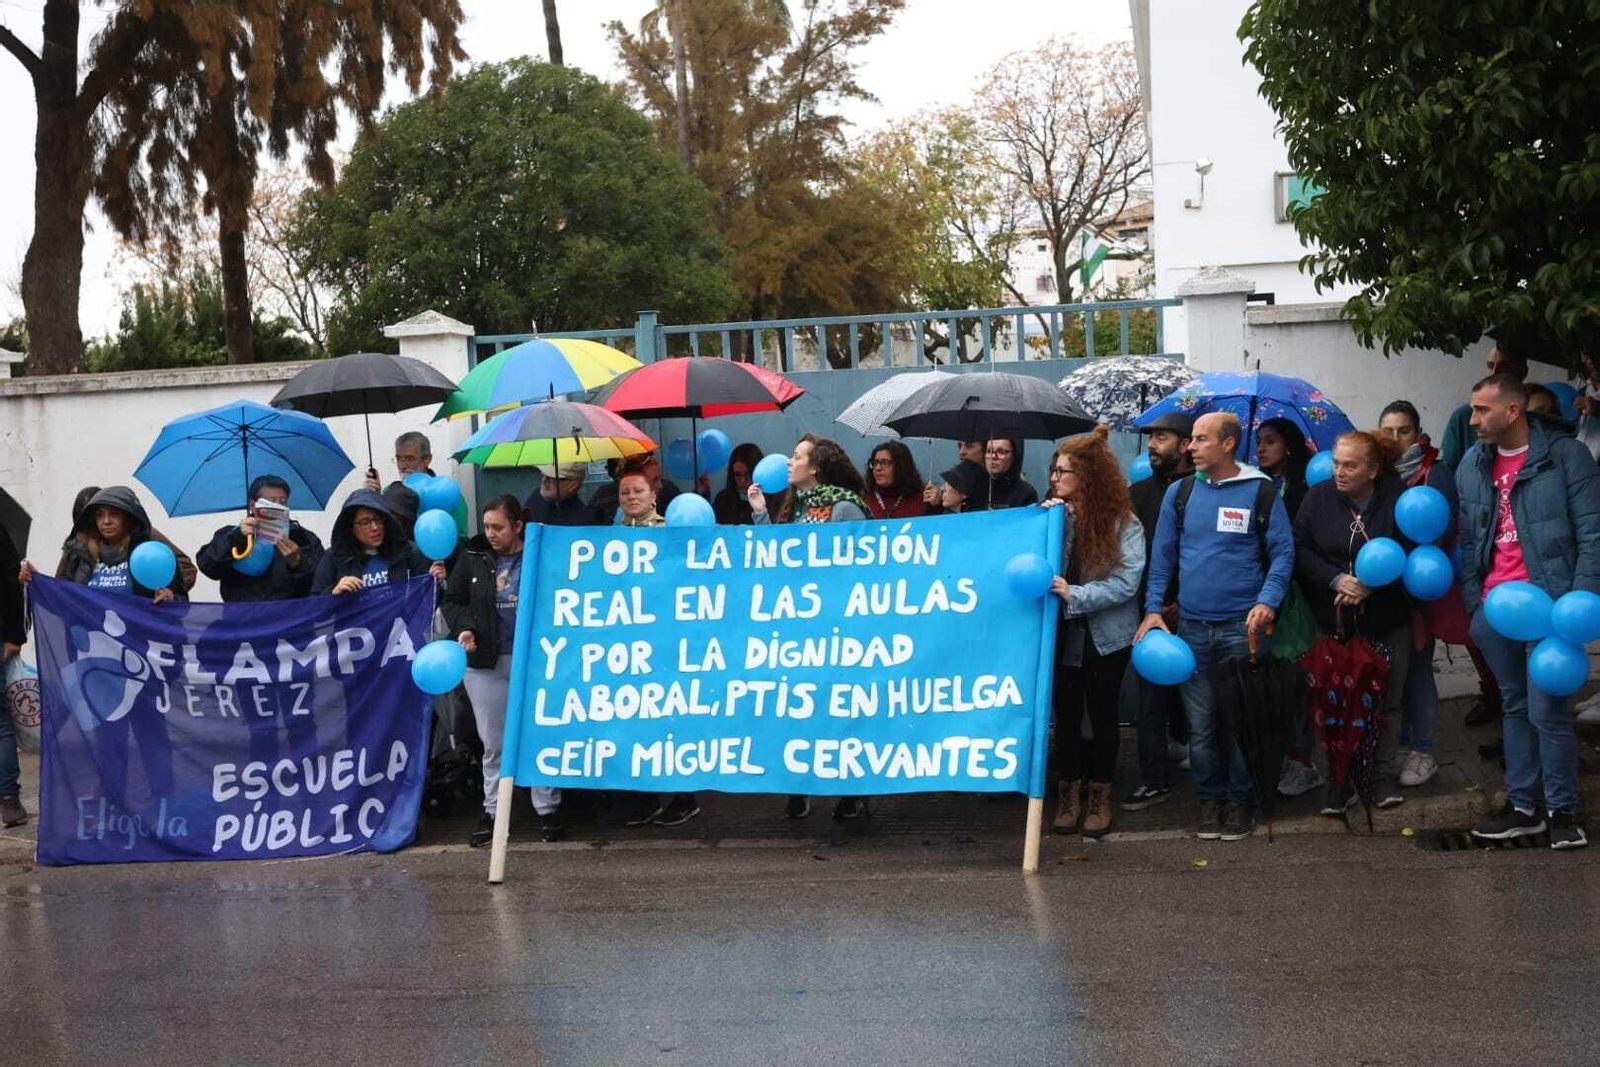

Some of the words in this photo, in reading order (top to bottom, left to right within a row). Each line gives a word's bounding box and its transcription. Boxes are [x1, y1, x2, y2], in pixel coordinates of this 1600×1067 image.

[569, 540, 657, 580] POR
[687, 538, 731, 570] LA
[554, 587, 656, 627] REAL
[675, 585, 725, 621] EN
[751, 583, 822, 621] LAS
[845, 578, 978, 617] AULAS
[147, 617, 416, 684] FLAMPA
[540, 637, 567, 680] Y
[582, 641, 653, 682] POR
[679, 638, 727, 672] LA
[155, 682, 311, 718] JEREZ
[829, 683, 879, 719] EN
[887, 675, 1023, 718] HUELGA
[213, 740, 409, 802] ESCUELA
[783, 736, 1018, 780] CERVANTES
[156, 797, 189, 839] la
